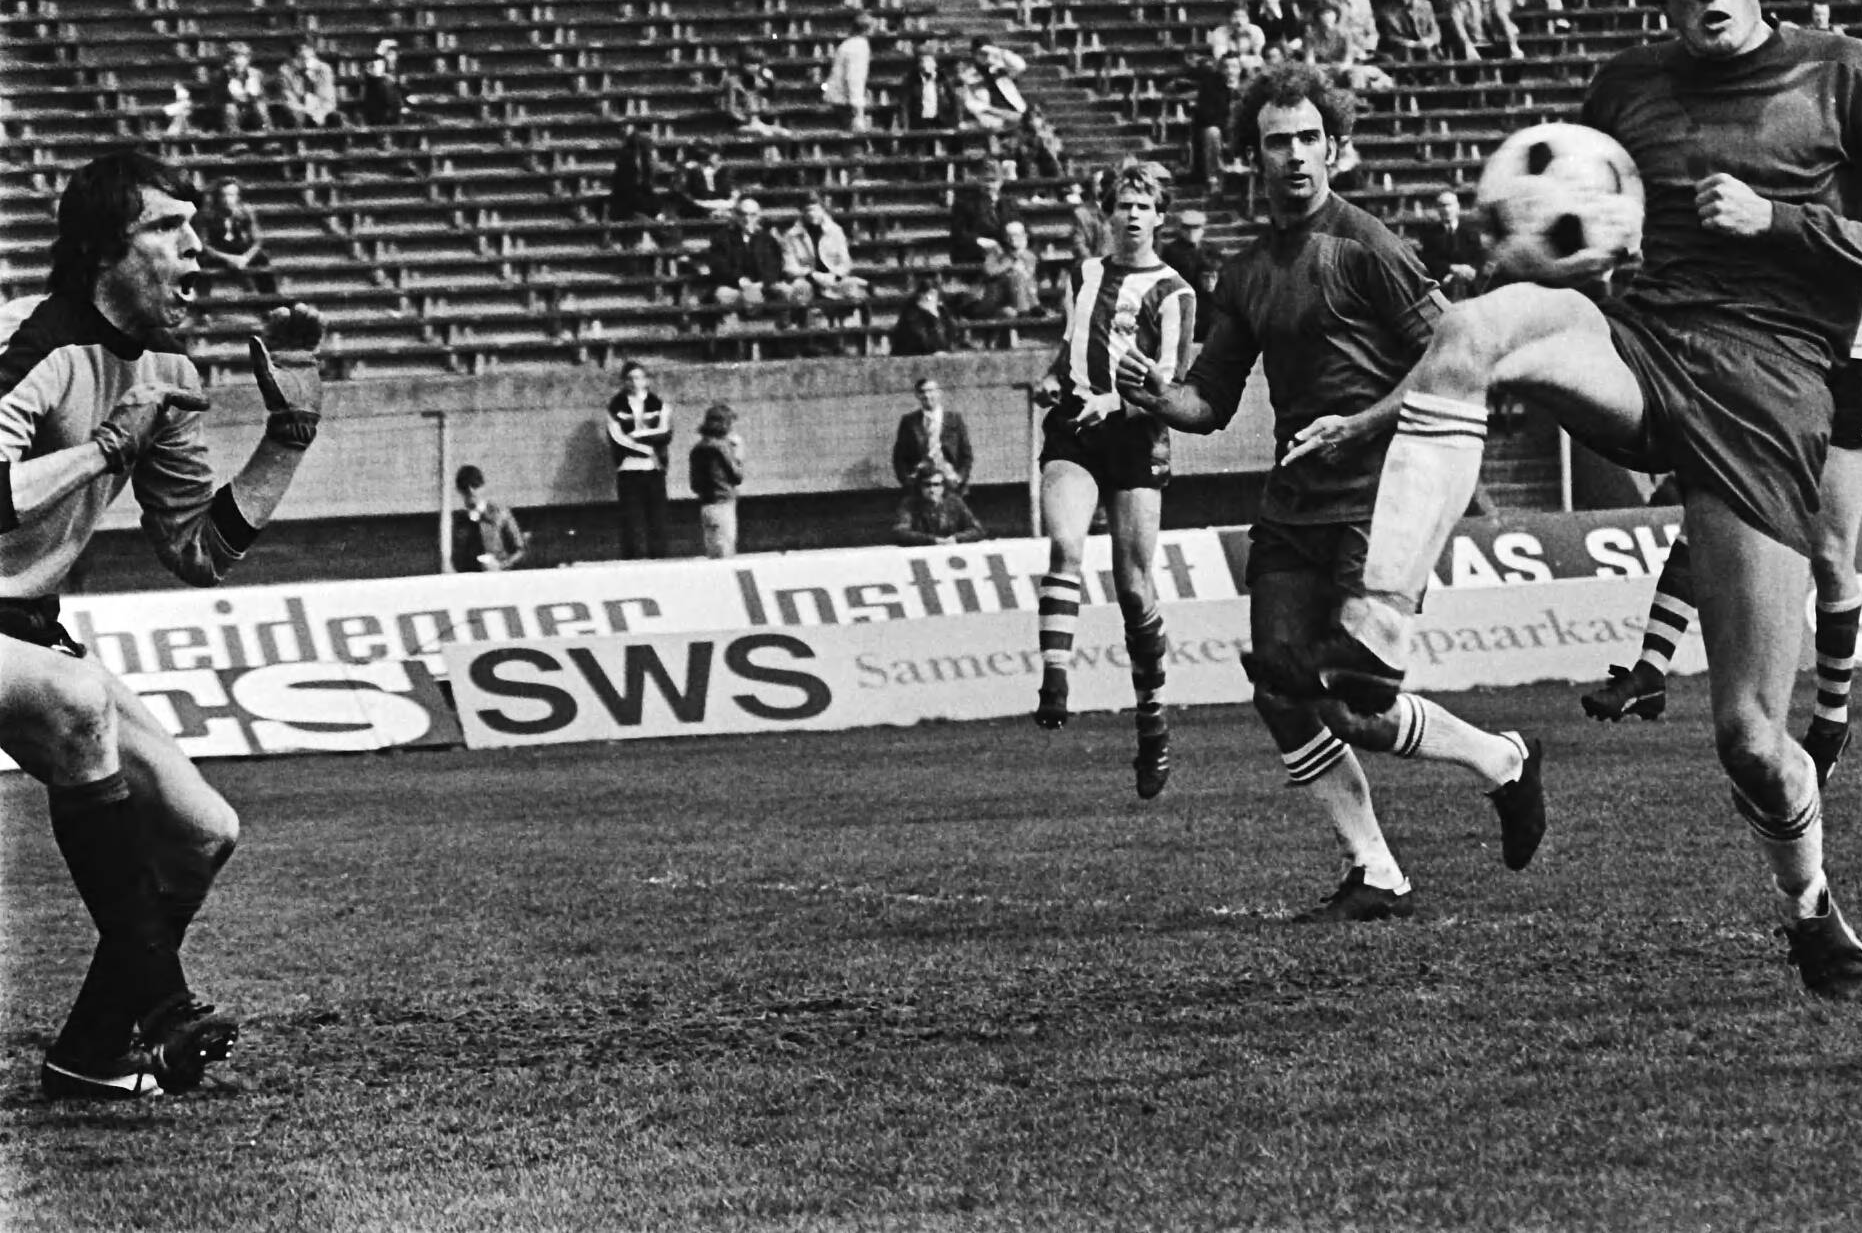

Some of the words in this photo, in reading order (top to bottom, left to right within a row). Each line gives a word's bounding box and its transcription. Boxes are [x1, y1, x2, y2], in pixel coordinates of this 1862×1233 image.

[1427, 532, 1555, 590] AS
[1585, 525, 1681, 580] SH
[469, 633, 832, 736] SWS
